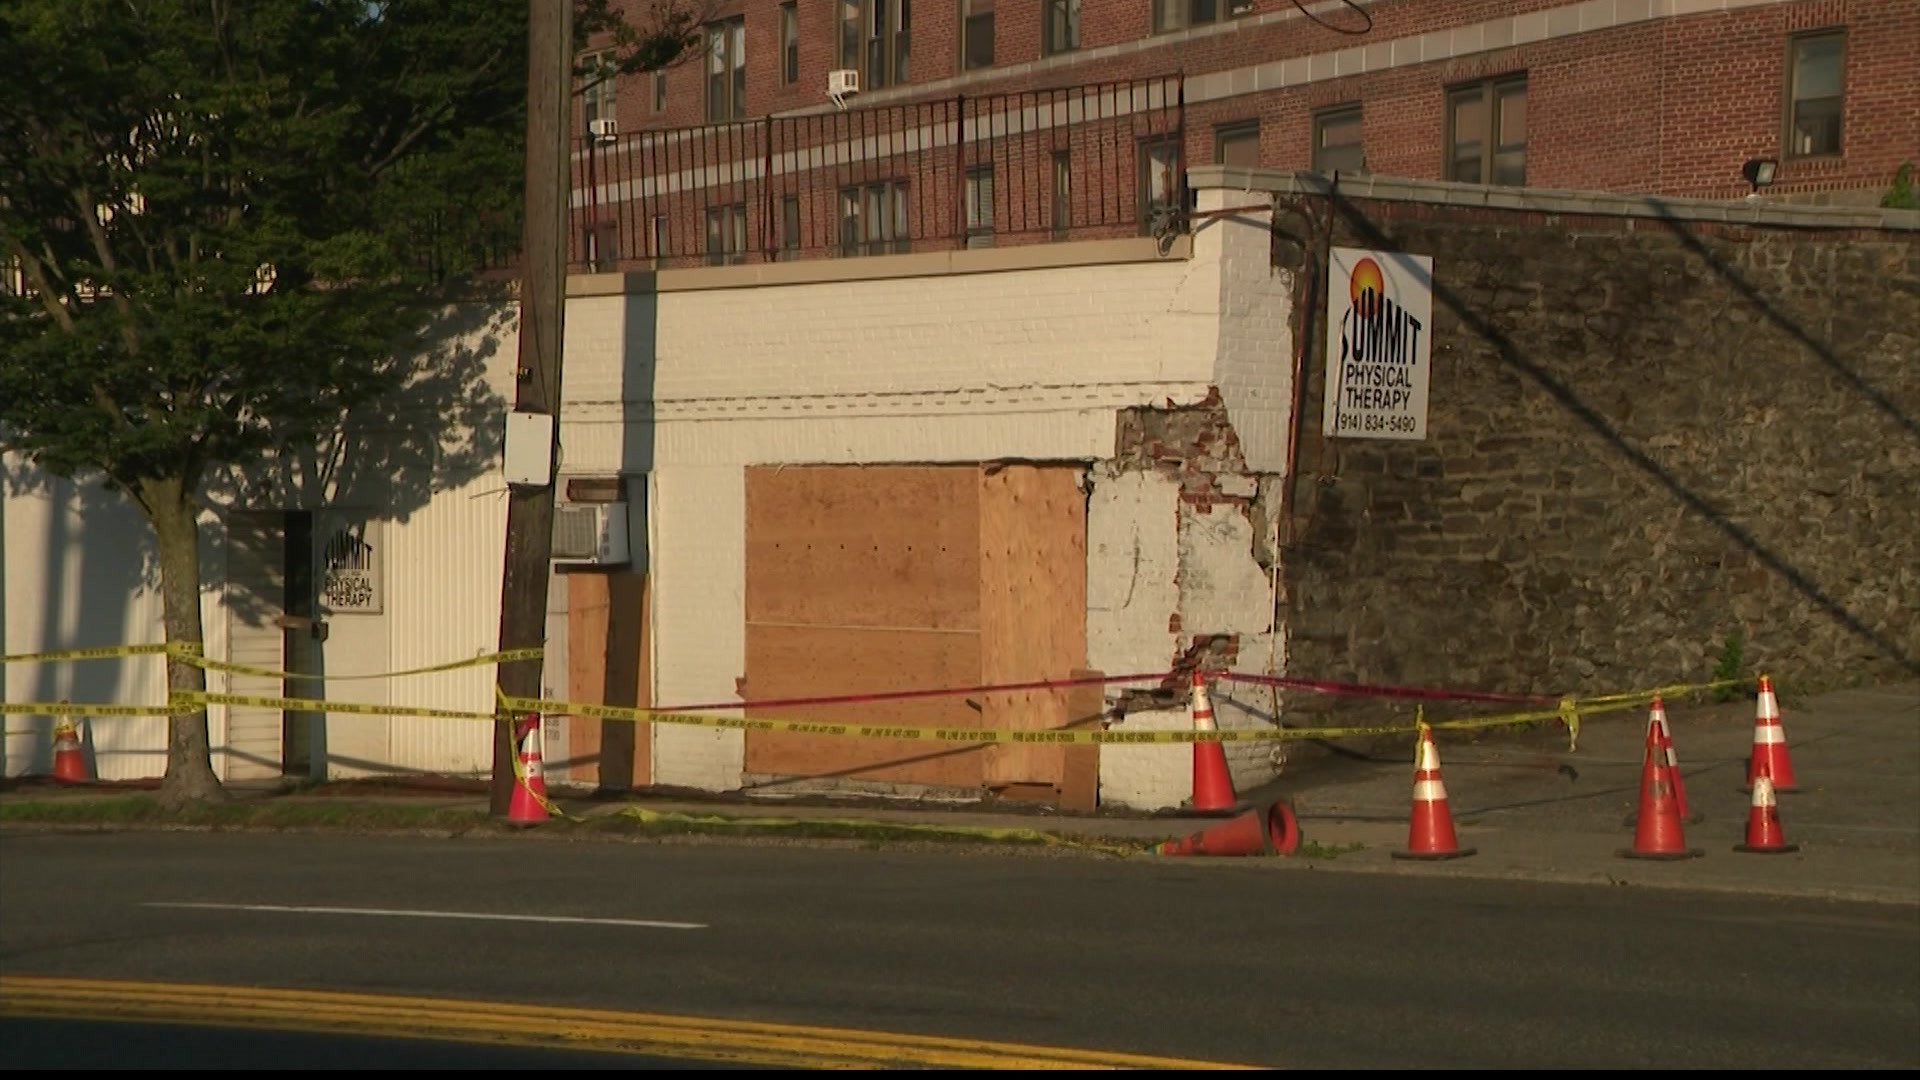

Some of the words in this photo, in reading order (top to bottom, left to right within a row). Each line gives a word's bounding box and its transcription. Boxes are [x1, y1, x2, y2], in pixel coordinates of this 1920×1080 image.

[1341, 286, 1422, 365] SUMMIT
[1345, 364, 1413, 388] PHYSICAL
[1345, 387, 1411, 411] THERAPY
[1337, 413, 1362, 431] (914)
[1364, 415, 1416, 432] 834-5490
[324, 530, 373, 571] SUMMIT
[324, 577, 373, 592] PHYSICAL
[326, 592, 372, 607] THERAPY
